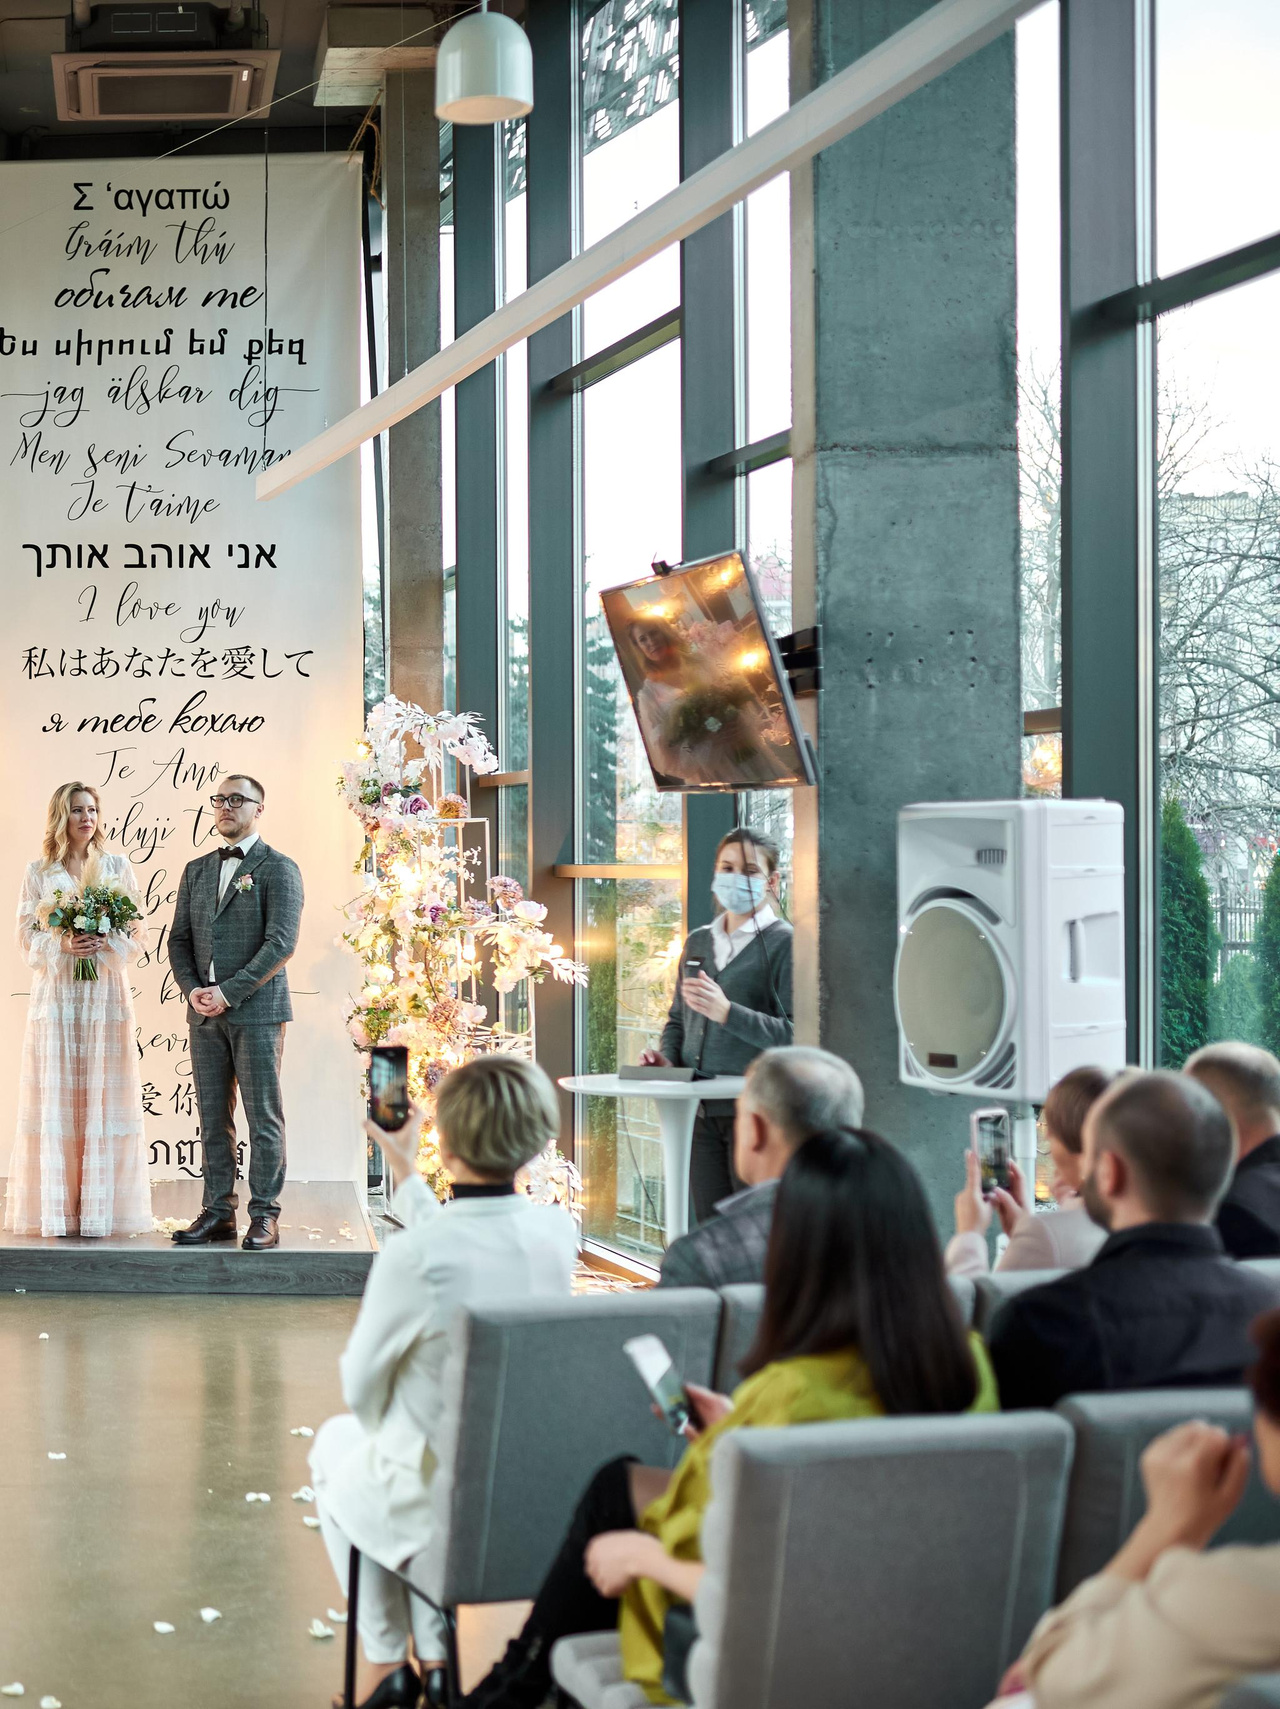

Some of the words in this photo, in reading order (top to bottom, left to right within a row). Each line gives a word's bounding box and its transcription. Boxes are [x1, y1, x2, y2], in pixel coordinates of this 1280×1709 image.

[73, 182, 94, 211] Σ
[54, 267, 188, 309] обичам
[201, 285, 264, 309] те
[55, 328, 174, 366] սիրում
[189, 328, 228, 355] եմ
[243, 328, 308, 366] քեզ
[1, 381, 91, 428] jag
[107, 364, 213, 415] älskar
[228, 364, 321, 428] dig
[9, 431, 71, 475] Men
[83, 443, 148, 478] seni
[67, 480, 109, 521] Je
[22, 543, 110, 578] אותך
[123, 543, 211, 569] אוהב
[227, 543, 278, 569] אני
[77, 585, 98, 622] I
[116, 581, 182, 627] love
[179, 598, 246, 644] you
[21, 645, 315, 680] 私はあなたを愛して
[41, 713, 70, 733] я
[77, 698, 163, 734] тебе
[168, 690, 266, 737] кохаю
[95, 747, 136, 787] Te
[131, 747, 227, 797] Amo
[103, 801, 176, 865] iluji
[141, 1082, 198, 1117] 爱你
